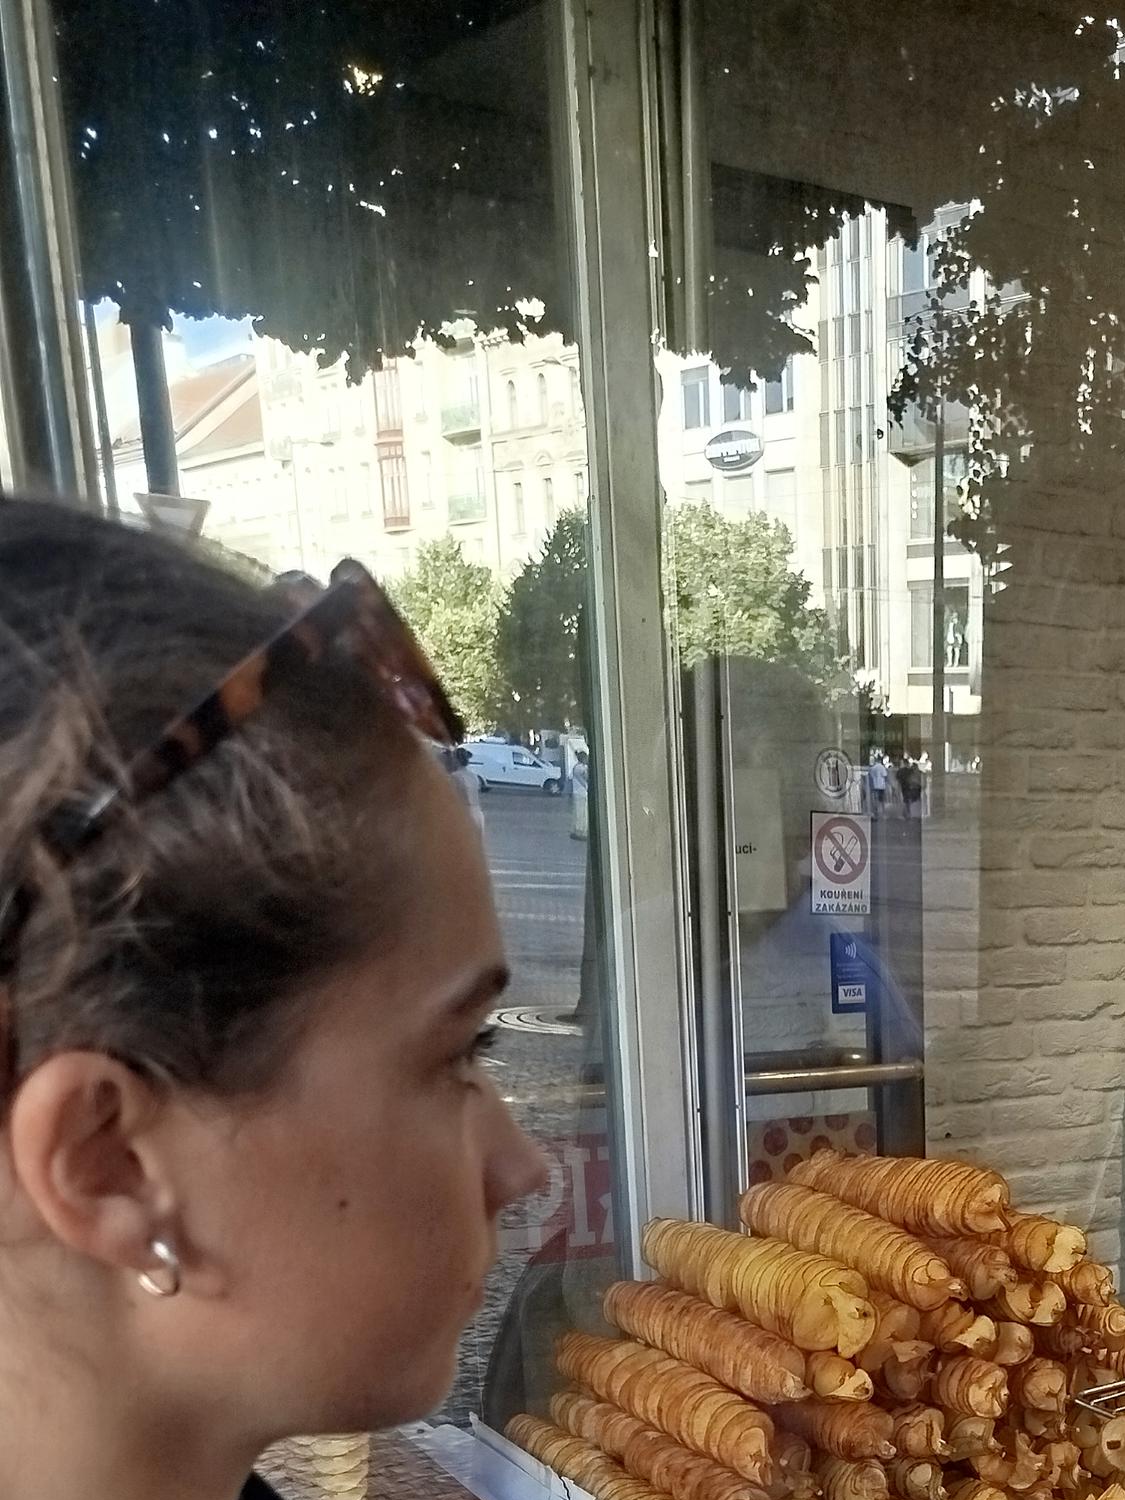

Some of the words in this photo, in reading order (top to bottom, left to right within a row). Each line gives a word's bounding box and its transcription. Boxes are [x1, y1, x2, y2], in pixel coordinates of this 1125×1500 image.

[820, 889, 864, 900] KOUŘENÍ
[815, 902, 868, 913] ZAKÁZÁNO
[842, 987, 862, 998] VISA
